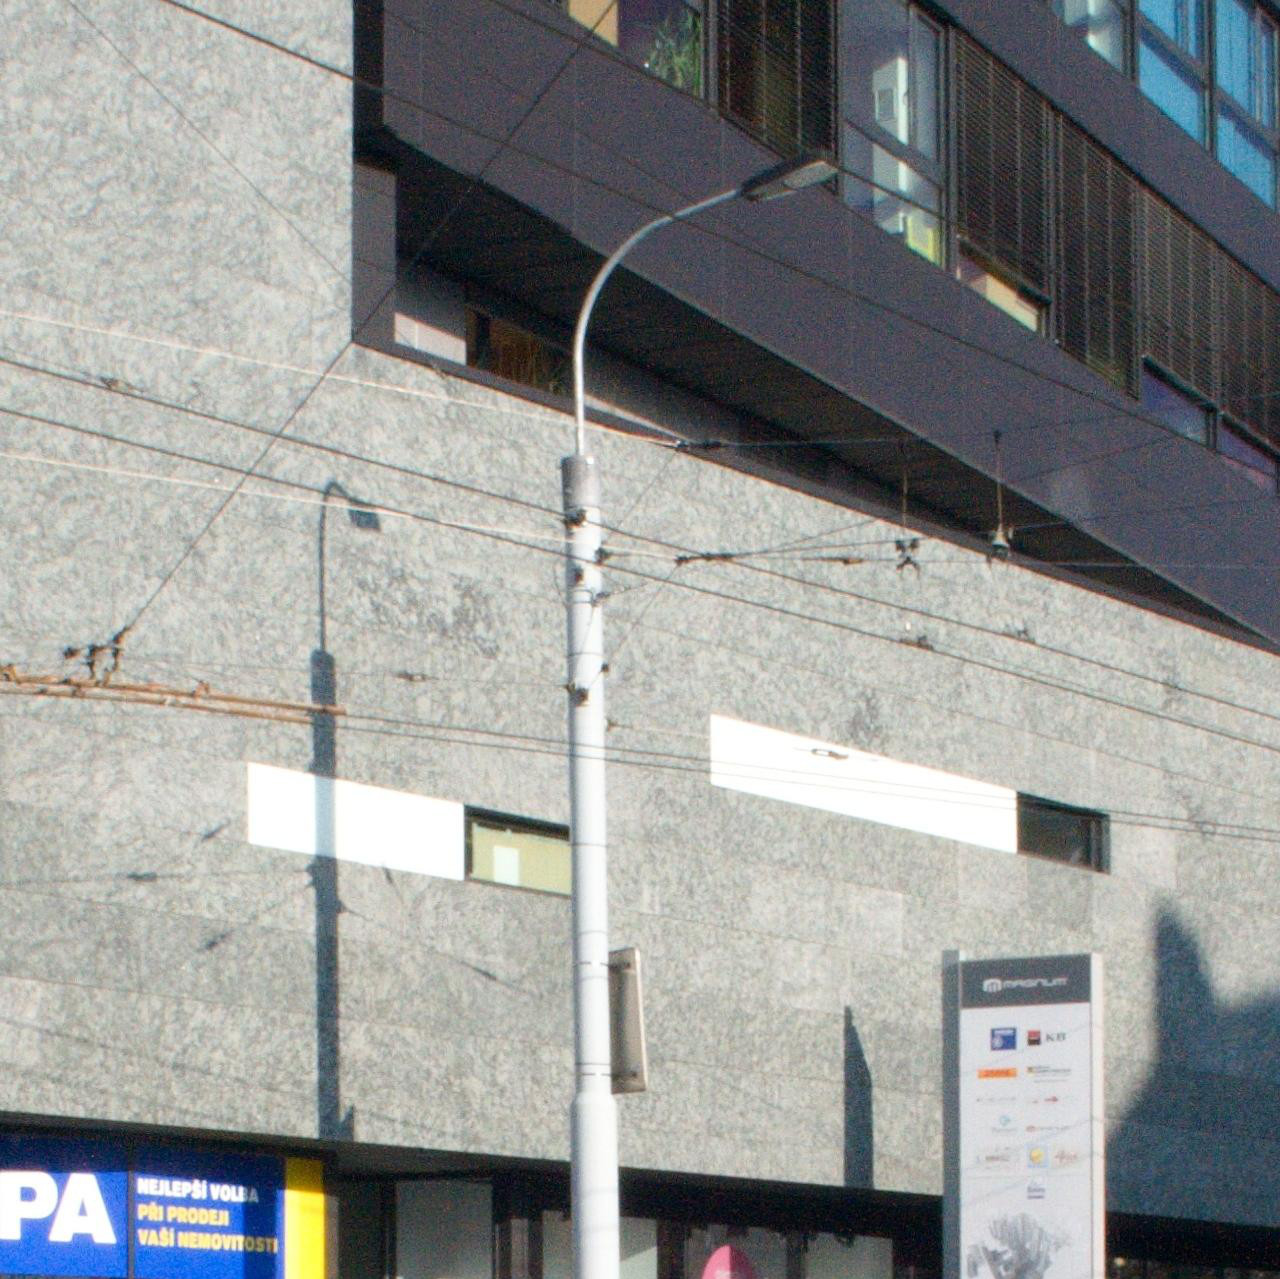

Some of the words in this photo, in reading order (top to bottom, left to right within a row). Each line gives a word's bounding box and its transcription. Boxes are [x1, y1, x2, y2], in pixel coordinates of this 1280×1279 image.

[137, 1178, 207, 1200] NEJLEPŠÍ
[209, 1183, 259, 1203] VOLBA
[137, 1202, 164, 1221] PŘI
[166, 1206, 230, 1226] PRODEJI
[137, 1227, 175, 1248] VAŠÍ
[177, 1231, 278, 1254] NEMOVITOSTI
